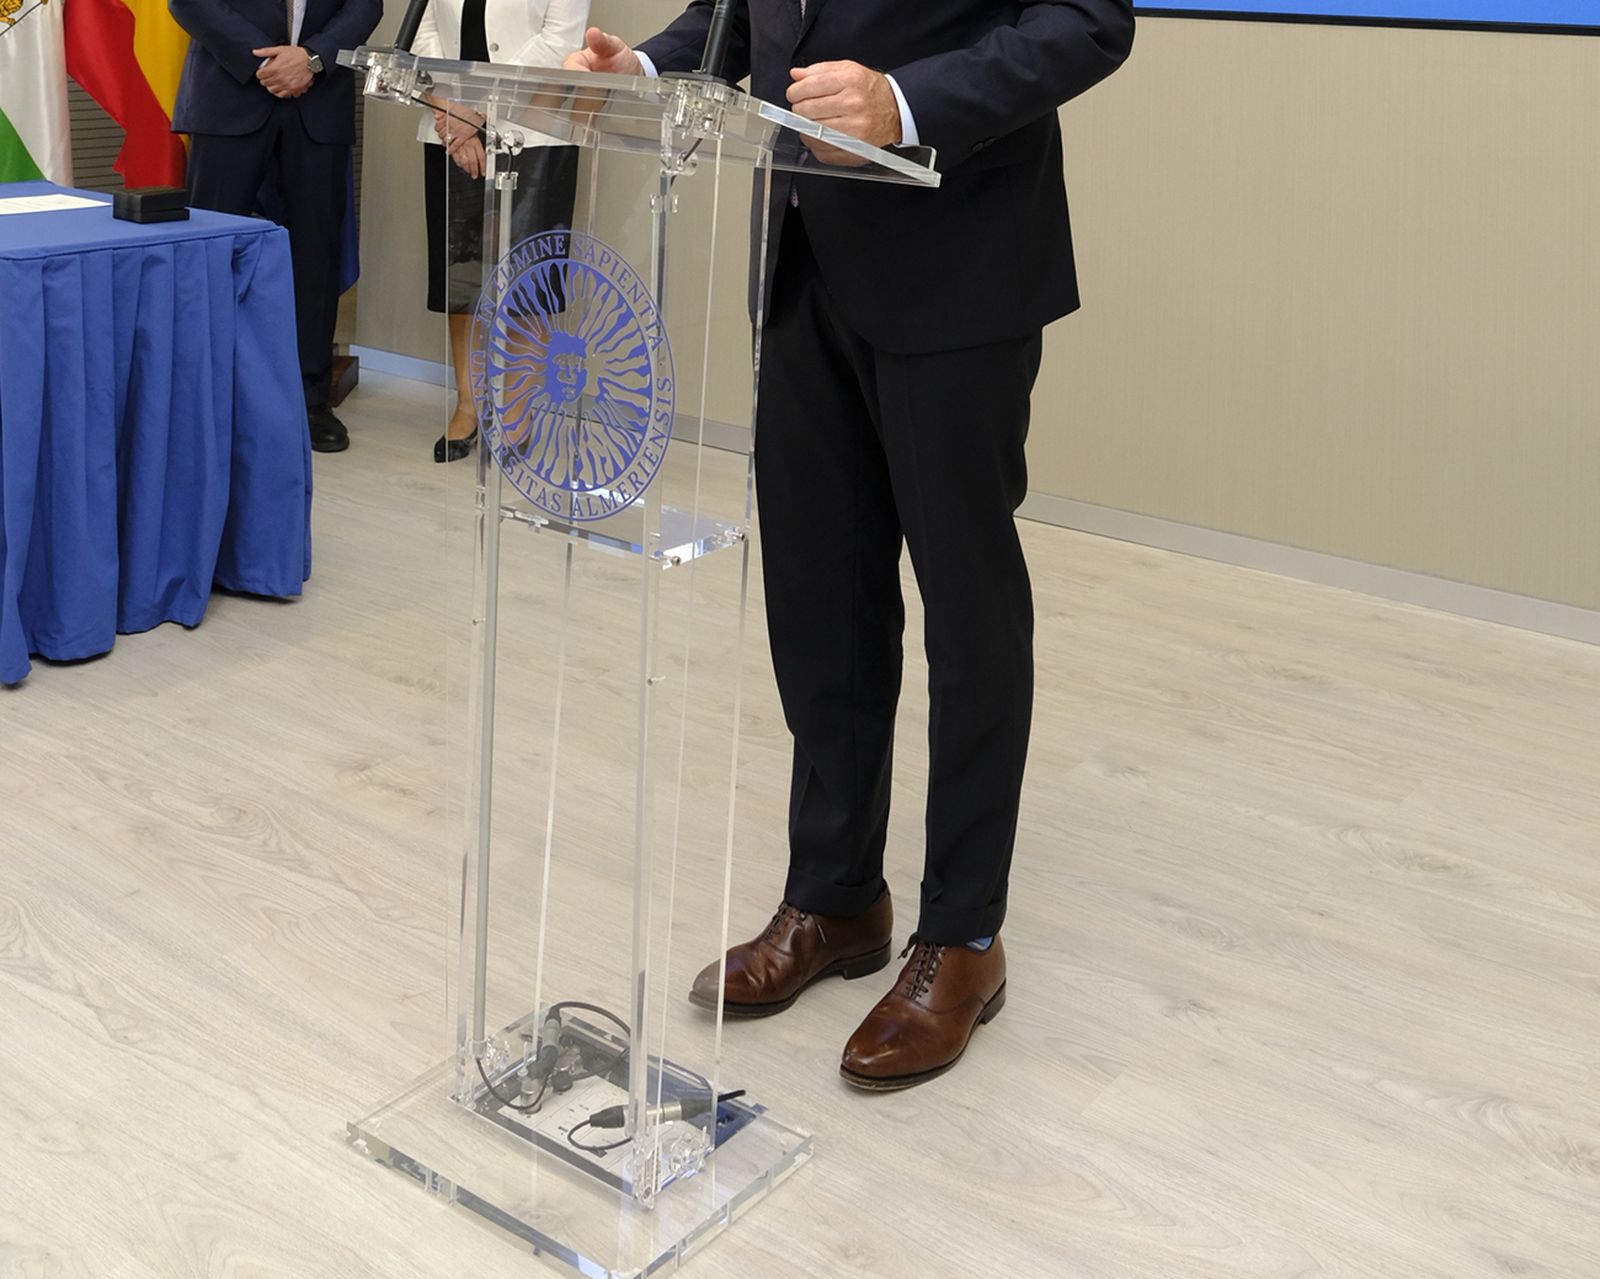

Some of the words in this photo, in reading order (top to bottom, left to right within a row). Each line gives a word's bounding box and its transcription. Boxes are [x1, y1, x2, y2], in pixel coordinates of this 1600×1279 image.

[492, 235, 566, 293] LUMINE
[572, 237, 663, 352] SAPIENTIA
[471, 350, 562, 512] UNIVERSITAS
[572, 376, 672, 518] ALMERIENSIS
